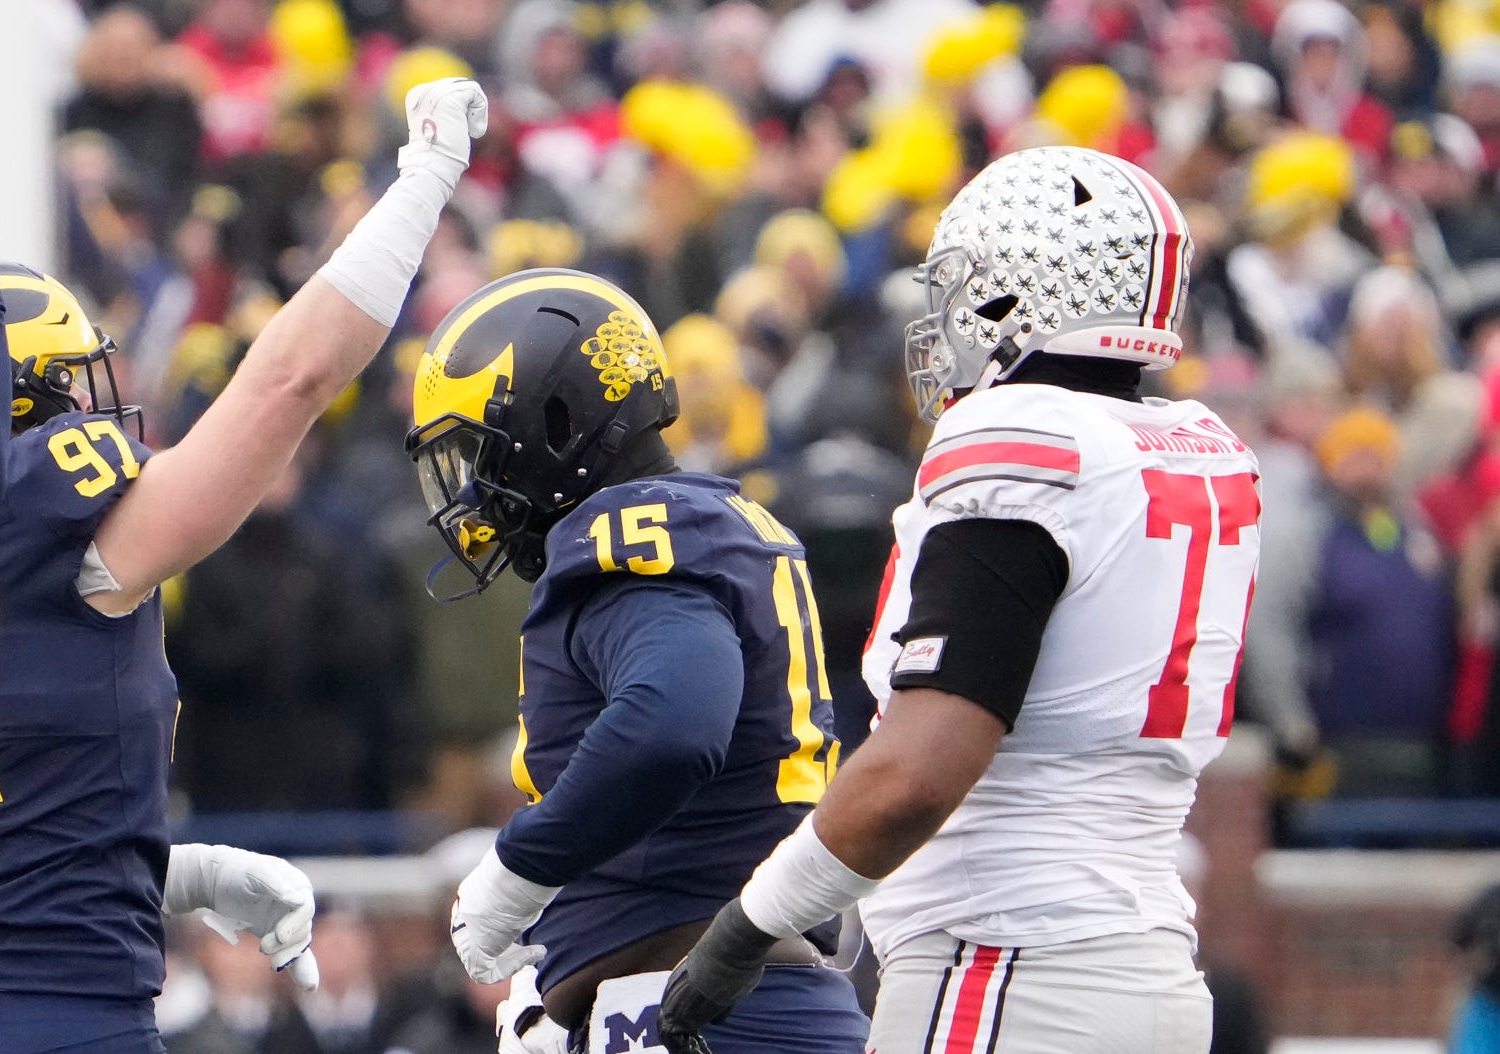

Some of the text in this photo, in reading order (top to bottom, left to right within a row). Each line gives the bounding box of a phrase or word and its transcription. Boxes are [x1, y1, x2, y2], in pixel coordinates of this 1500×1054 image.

[650, 373, 664, 392] 15
[47, 420, 140, 498] 97
[590, 503, 675, 575] 15
[1139, 468, 1262, 739] 77
